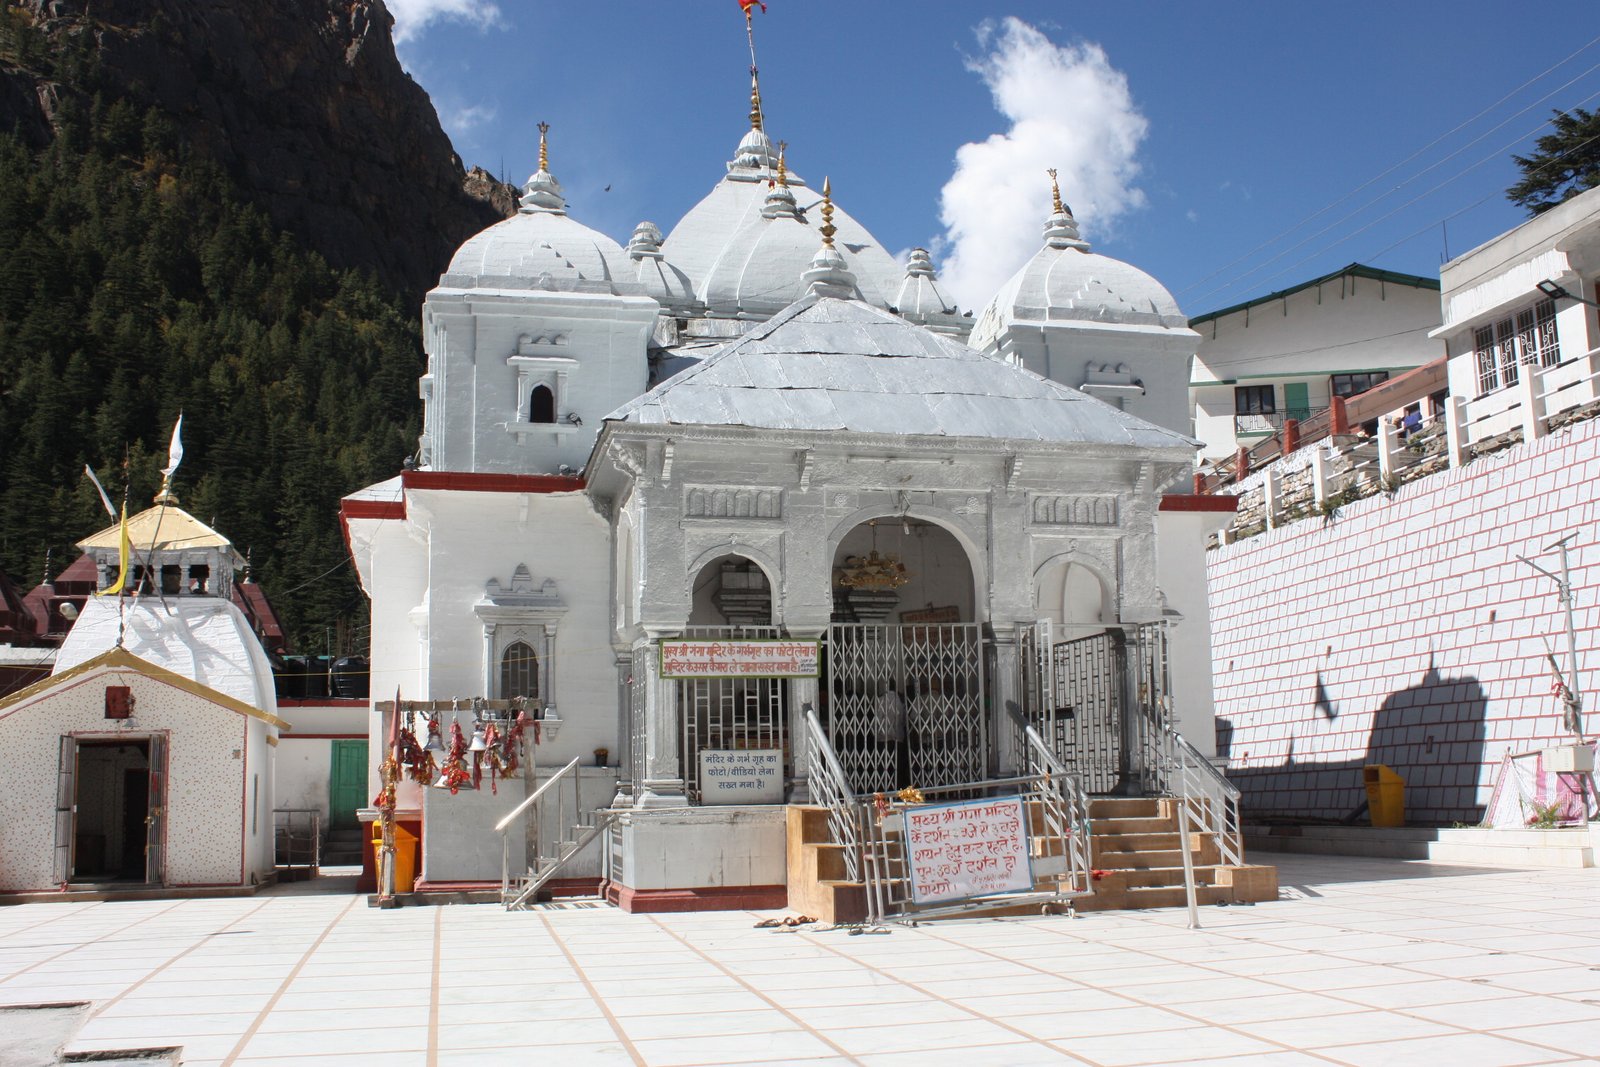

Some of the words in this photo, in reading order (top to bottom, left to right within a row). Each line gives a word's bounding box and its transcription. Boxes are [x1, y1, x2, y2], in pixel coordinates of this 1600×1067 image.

[679, 642, 689, 657] श्री
[690, 643, 704, 656] गंगा
[727, 642, 736, 656] के
[763, 645, 774, 657] का
[777, 642, 794, 656] फोटो
[794, 642, 809, 657] लेना
[810, 645, 818, 656] व
[729, 658, 738, 673] ले
[739, 661, 757, 672] जाना
[776, 661, 790, 672] मना
[705, 753, 724, 763] मंदिर
[727, 753, 735, 763] के
[737, 752, 750, 763] गर्भ
[752, 755, 764, 765] गृह
[766, 755, 776, 763] का
[758, 765, 775, 776] लेना
[718, 781, 737, 789] सख्त
[738, 781, 754, 789] मना
[756, 778, 765, 789] है।
[942, 808, 955, 824] श्री
[959, 806, 982, 821] गंगा
[984, 802, 1018, 817] मन्दिर
[923, 826, 950, 843] दर्शन
[979, 821, 989, 837] से
[999, 817, 1019, 833] बजे
[914, 847, 942, 862] शयन
[963, 841, 984, 854] बन्द
[986, 836, 1008, 855] रहते
[965, 856, 997, 874] दर्शन
